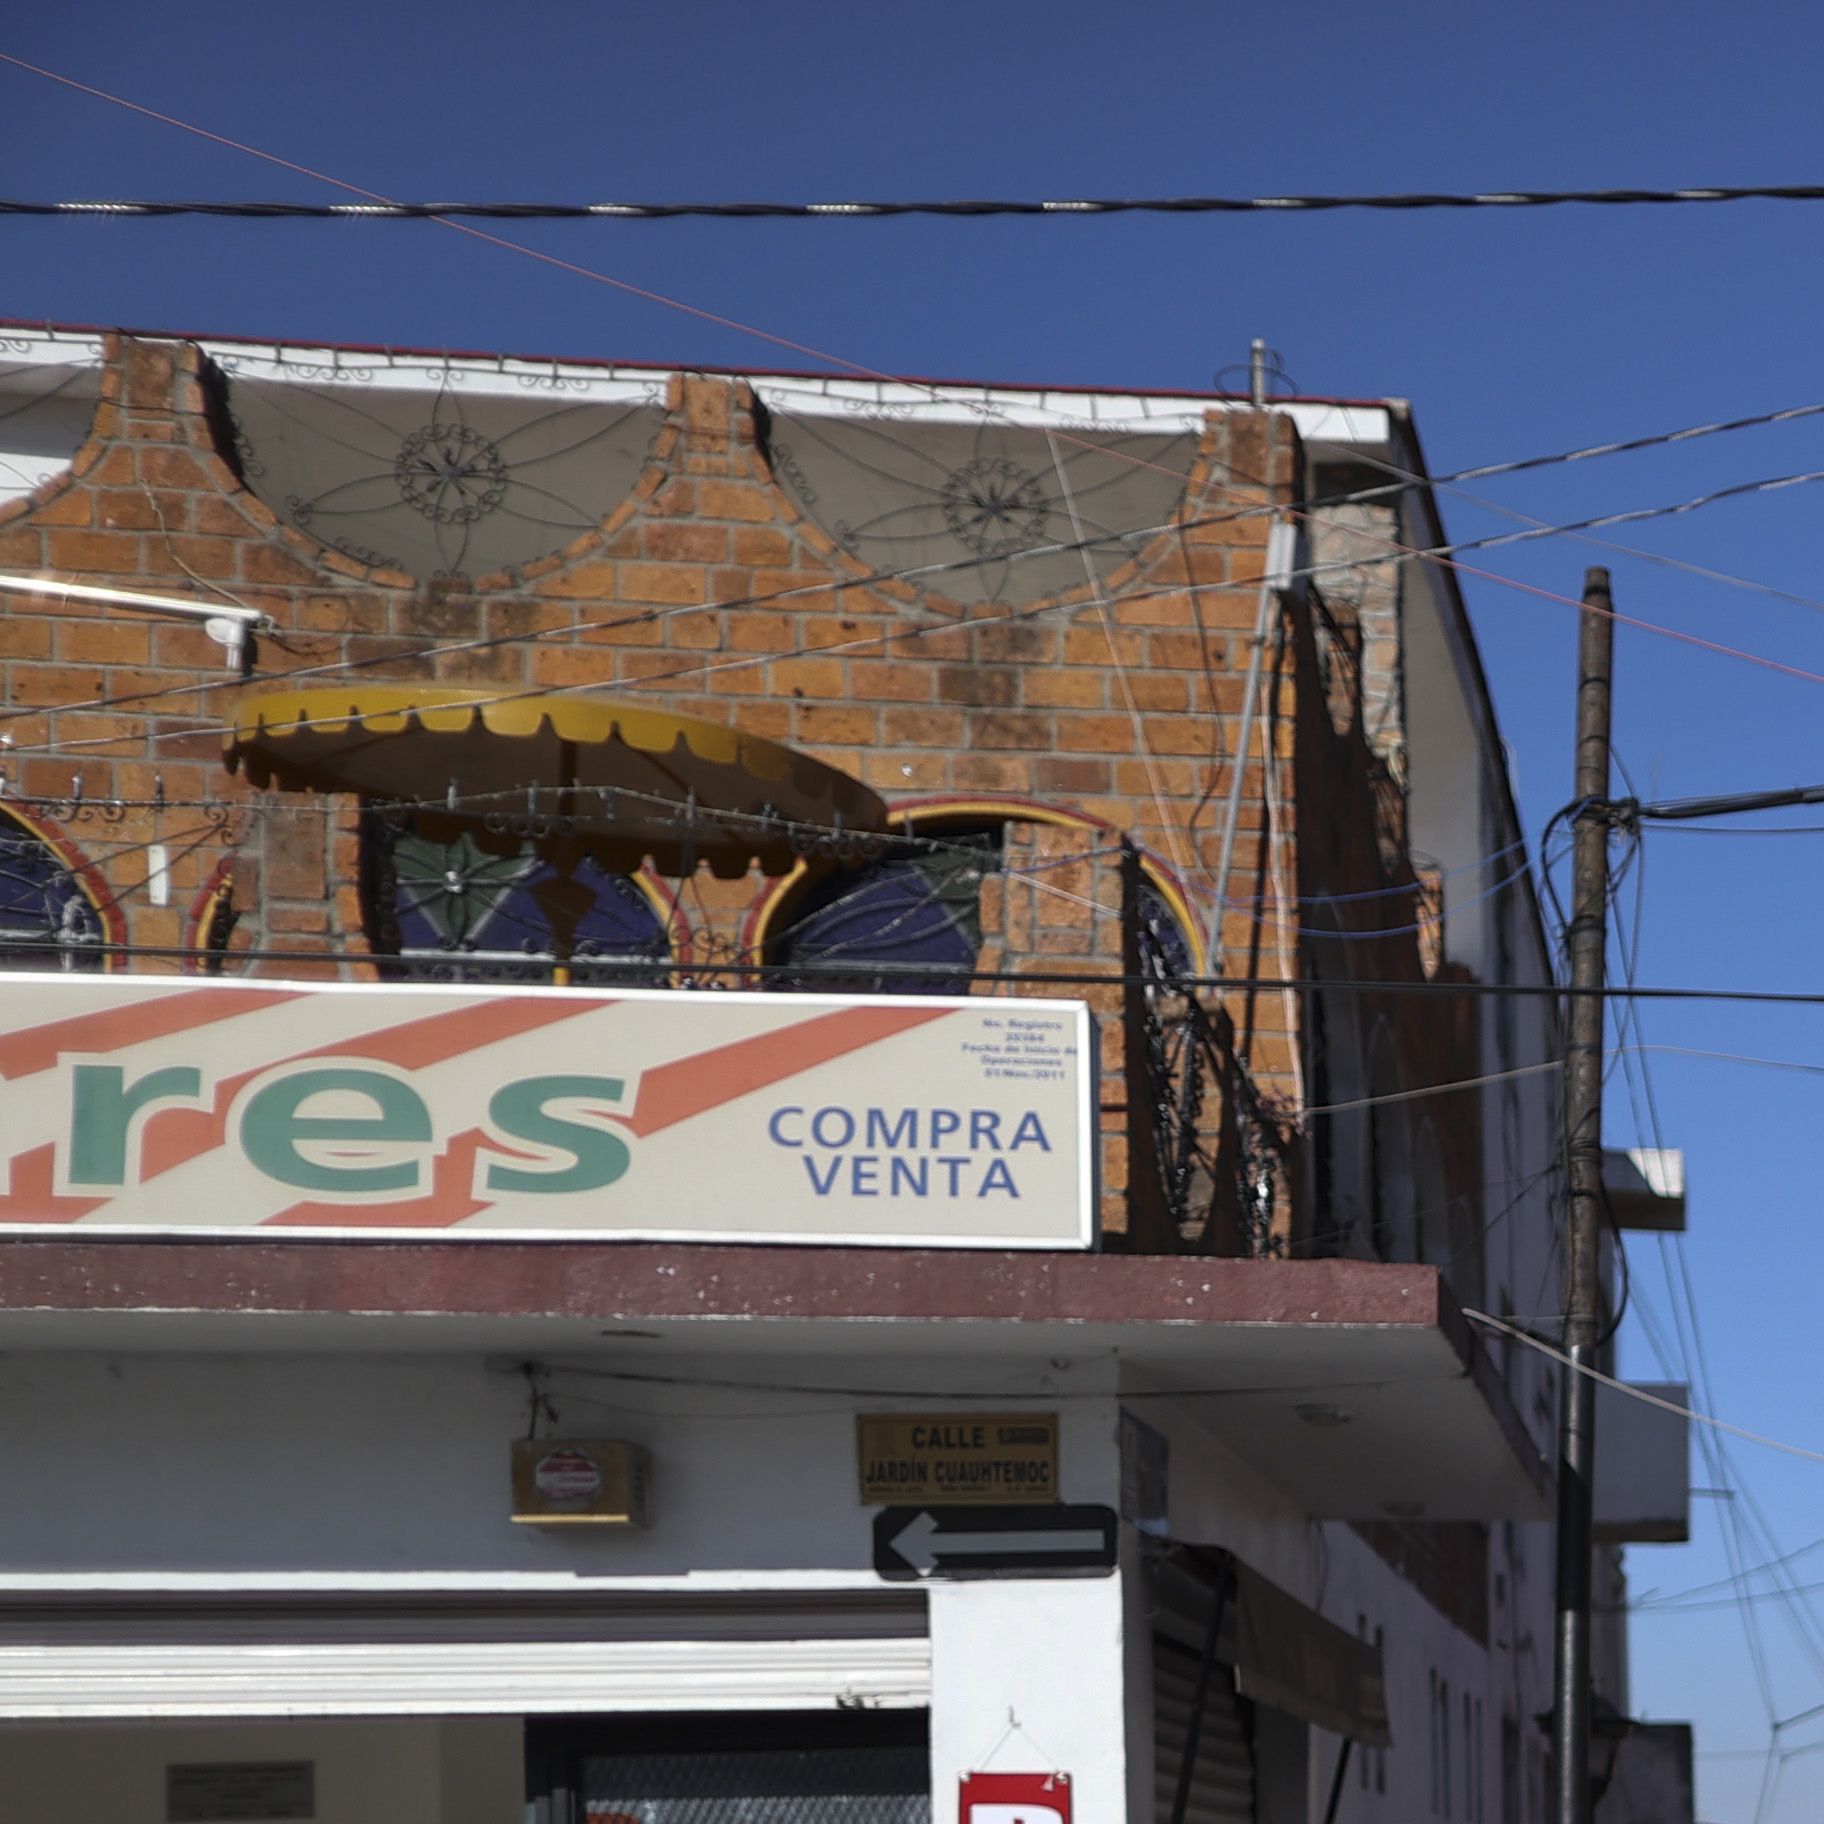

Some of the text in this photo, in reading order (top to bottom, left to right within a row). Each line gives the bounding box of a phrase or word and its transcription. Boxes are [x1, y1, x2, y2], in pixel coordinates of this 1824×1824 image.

[768, 1105, 1053, 1152] COMPRA
[802, 1154, 1021, 1199] VENTA
[911, 1426, 985, 1448] CALLE
[867, 1456, 928, 1483] JARDÍN
